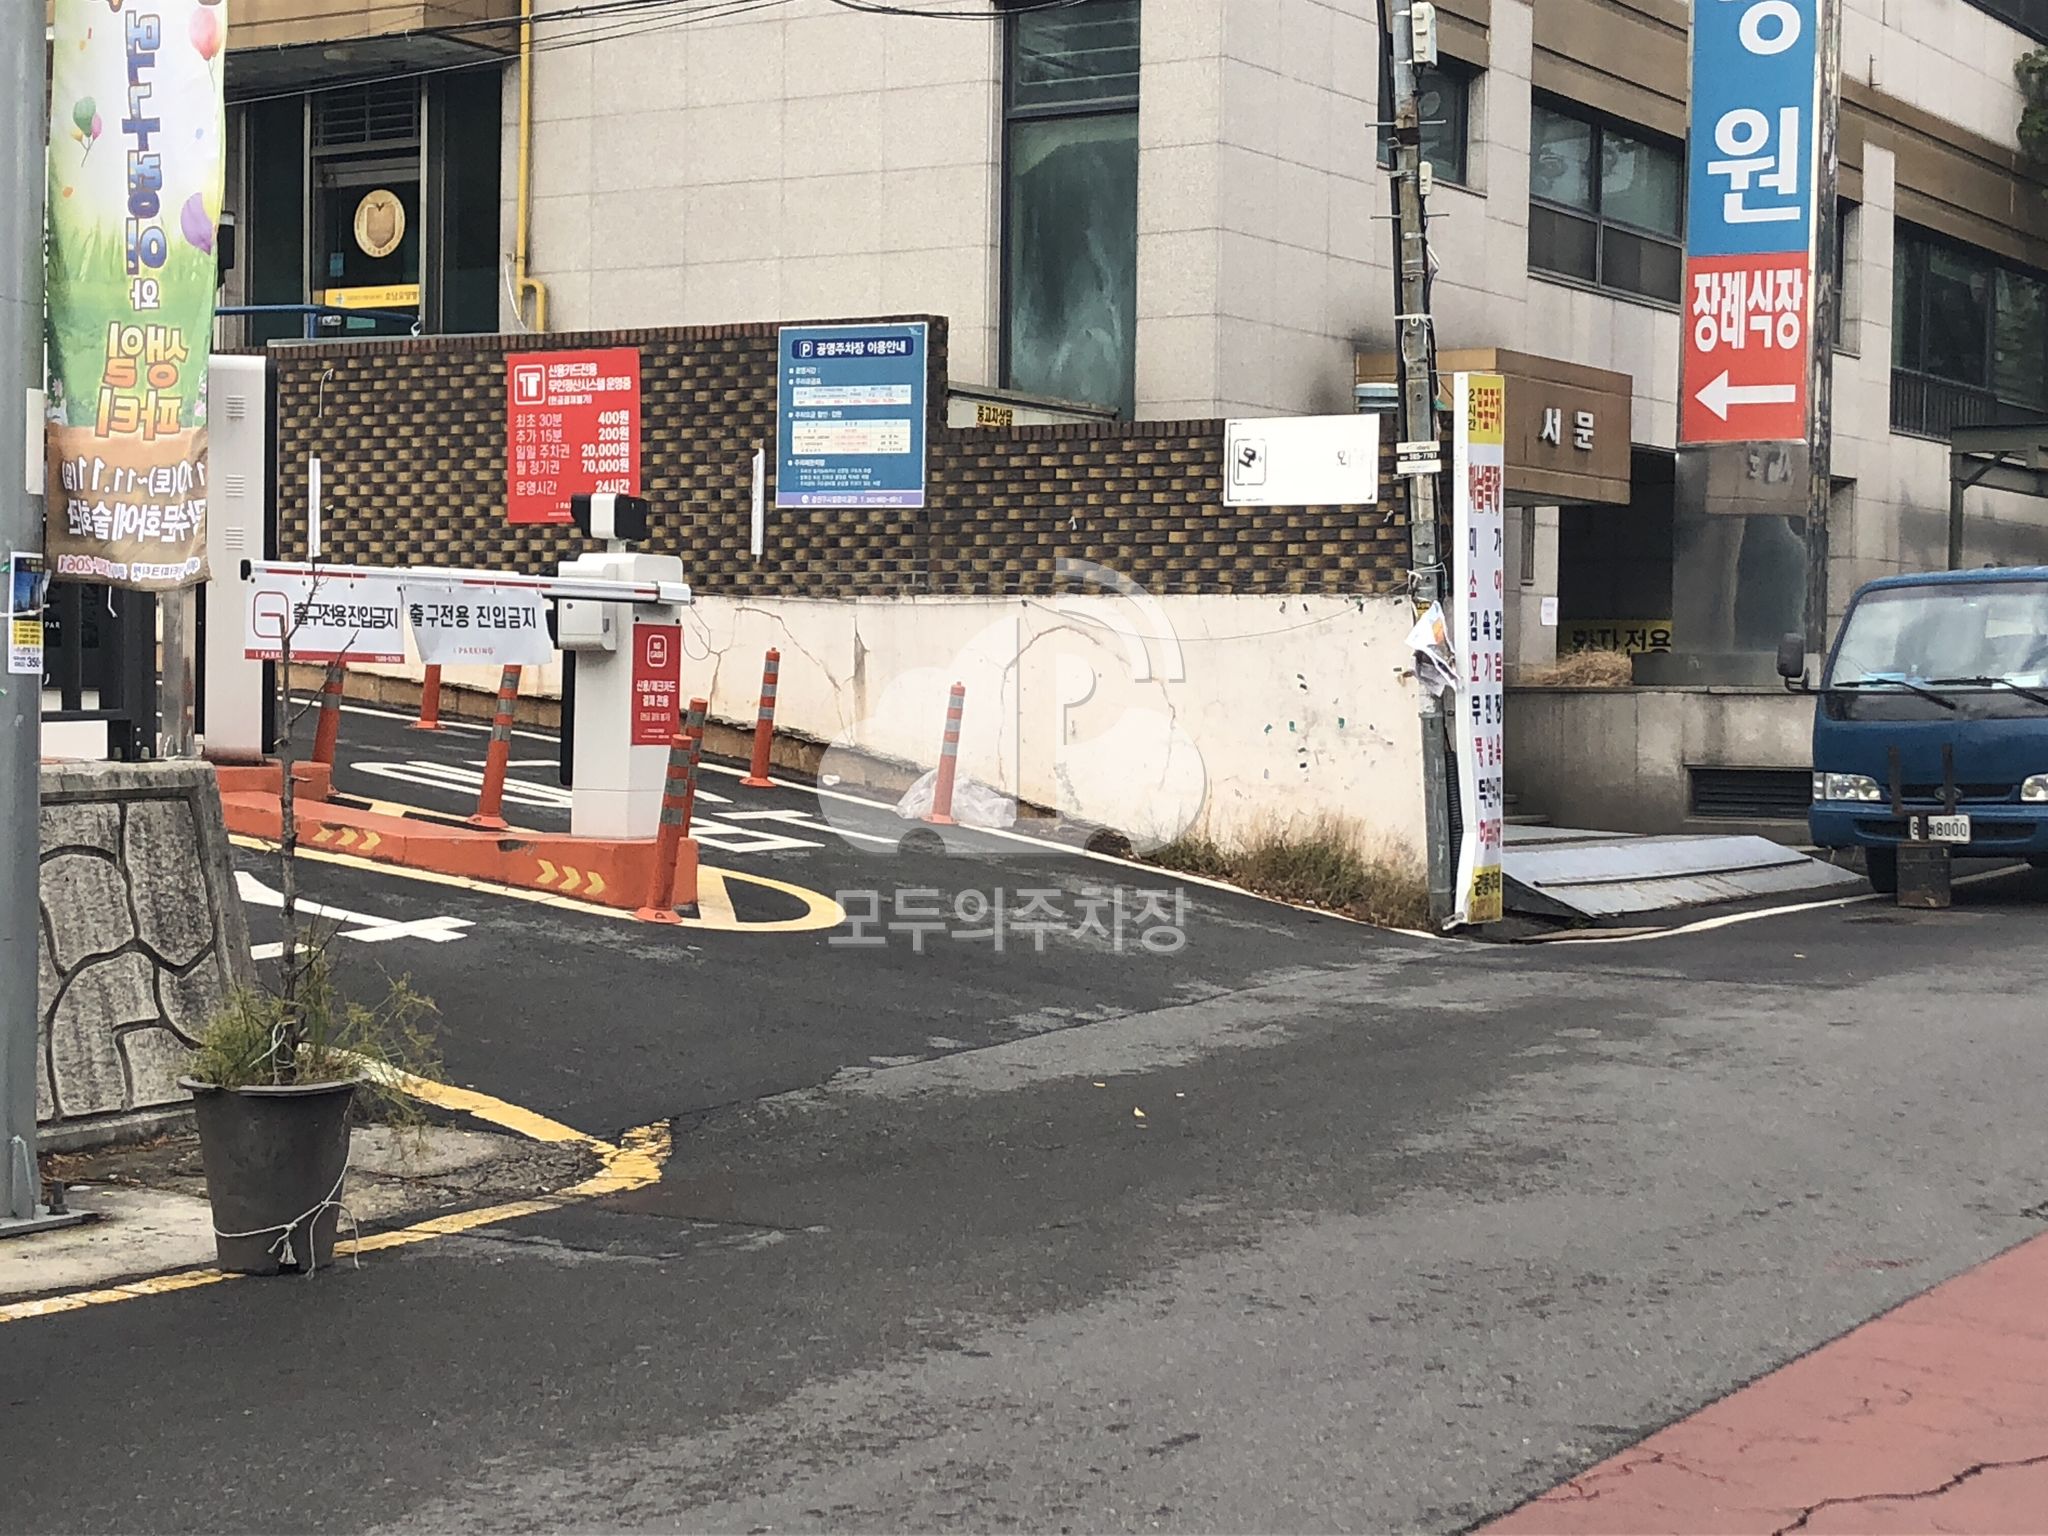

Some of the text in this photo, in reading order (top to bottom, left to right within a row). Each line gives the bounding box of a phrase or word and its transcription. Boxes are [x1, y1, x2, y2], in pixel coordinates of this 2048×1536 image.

[1693, 268, 1803, 352] 장례식장
[816, 341, 864, 356] 공영주차장
[868, 340, 906, 354] 이용안내
[607, 377, 632, 390] 운영중
[515, 410, 630, 428] 최초 30분 400원
[516, 426, 630, 444] 추가 15분 200원
[515, 443, 630, 460] 일일 주차권 20,000원
[516, 458, 630, 475] 월 정기권 70,000원
[516, 479, 631, 496] 운영시간 24시간
[293, 602, 398, 630] 출구전용 진입금지
[409, 603, 537, 630] 출구전용 진입금지
